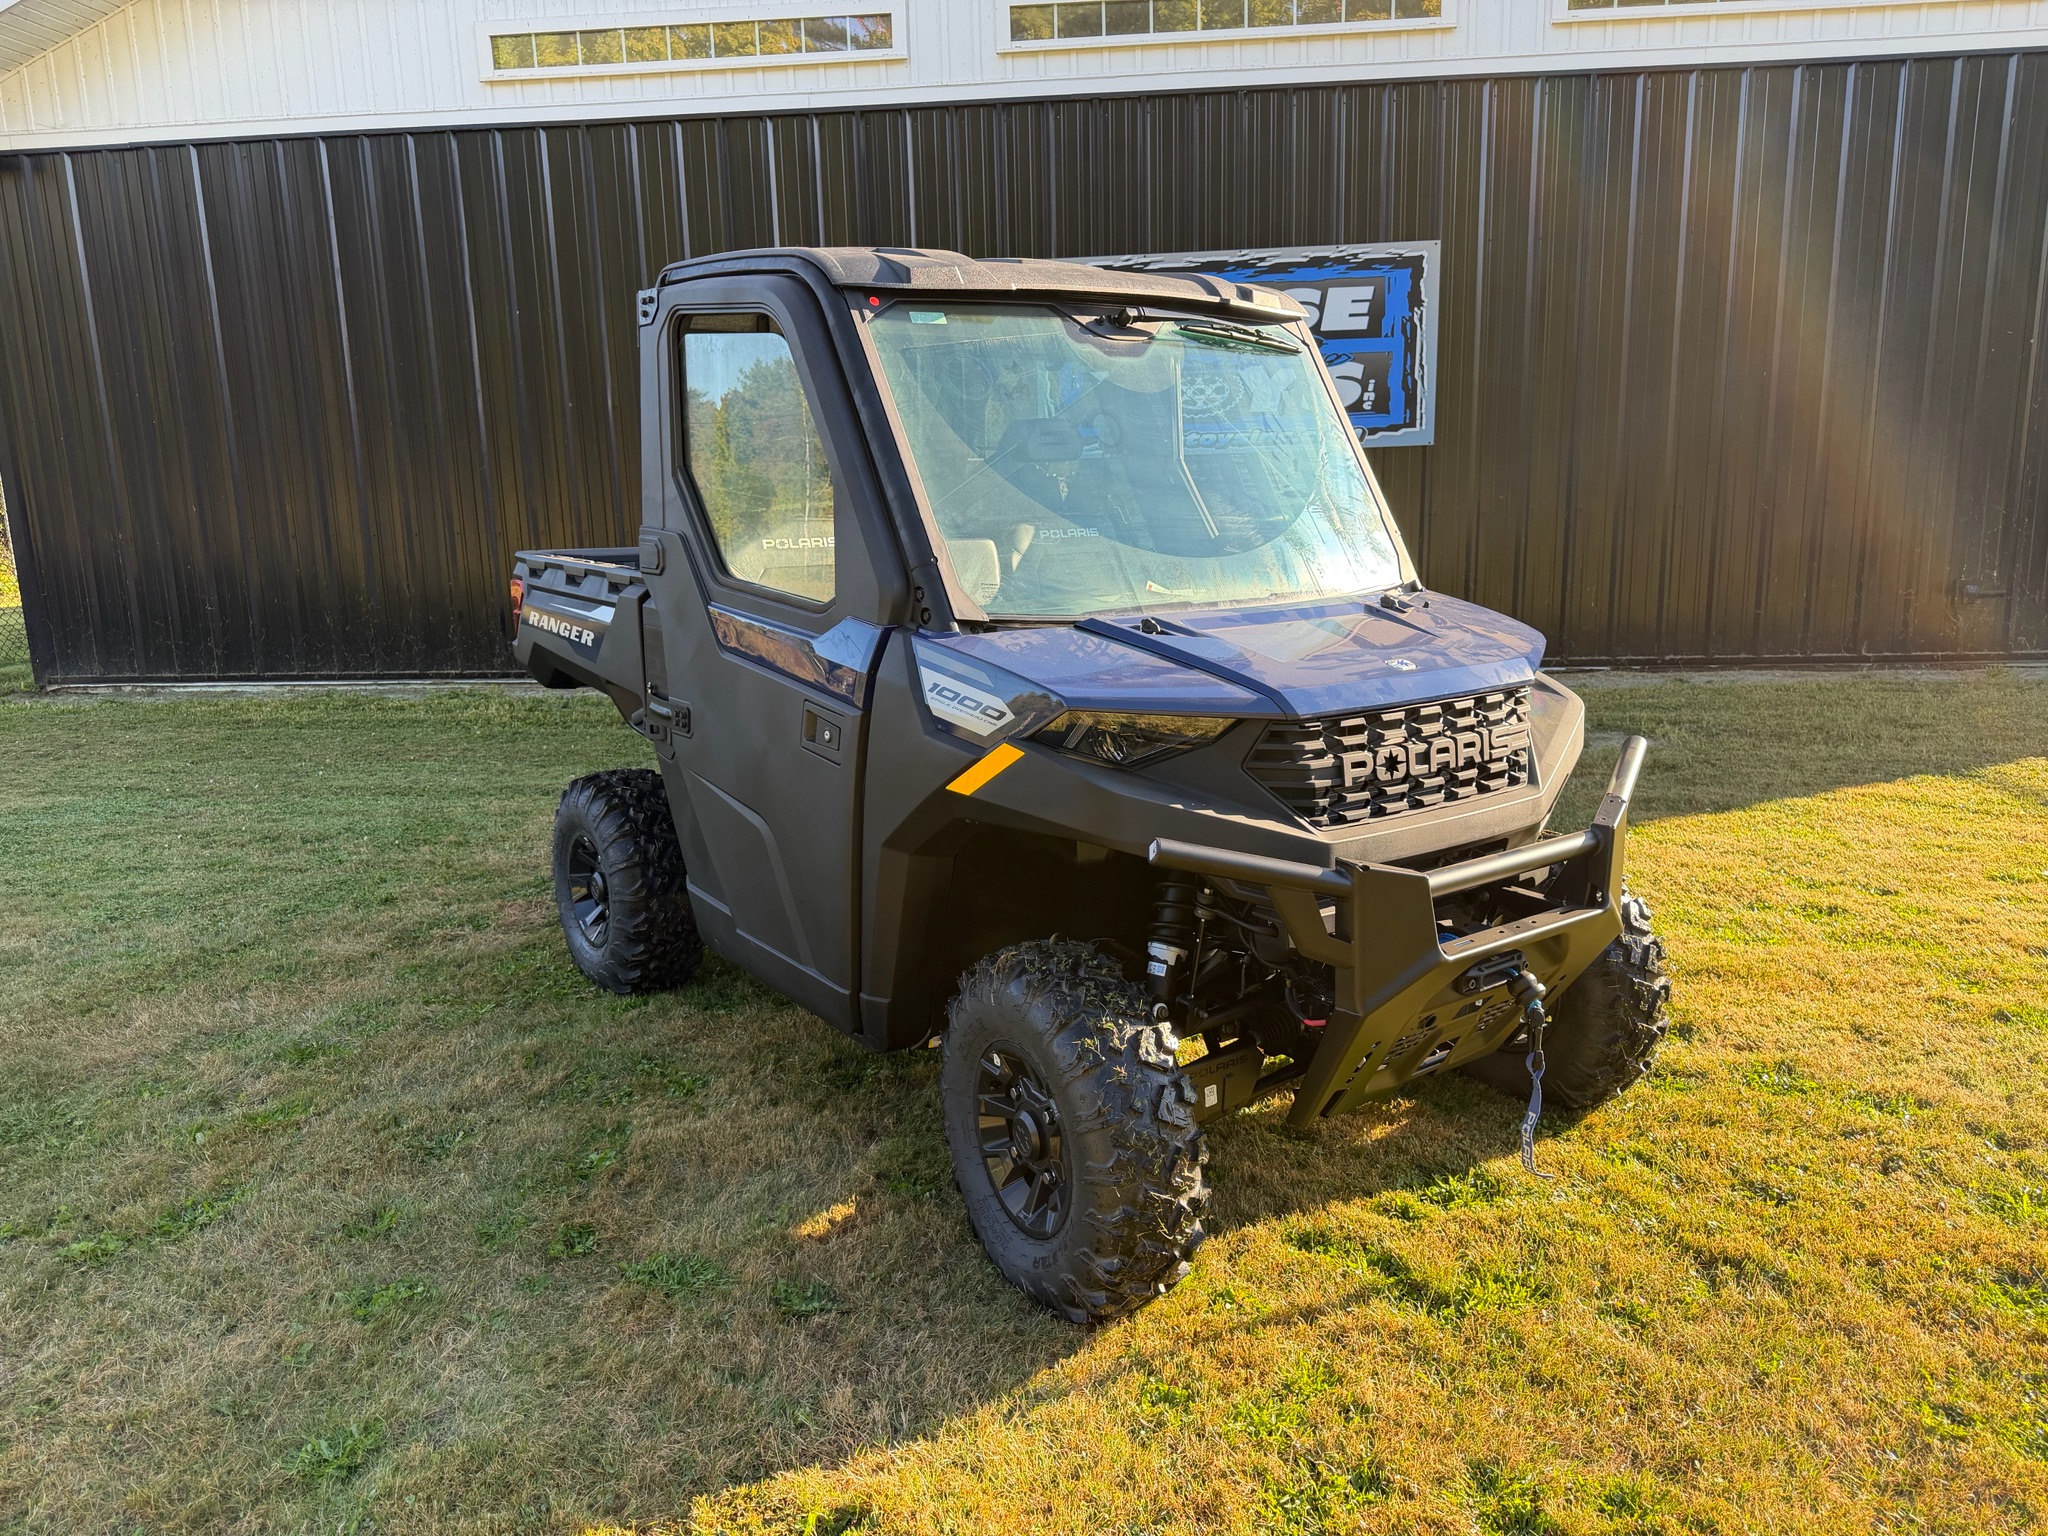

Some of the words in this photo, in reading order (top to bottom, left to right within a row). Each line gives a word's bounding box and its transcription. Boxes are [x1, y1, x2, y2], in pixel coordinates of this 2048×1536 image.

[1362, 379, 1376, 410] inc
[762, 536, 835, 550] POLARIS
[1039, 527, 1099, 539] POLARIS
[528, 610, 595, 647] RANGER
[927, 682, 1007, 721] 1000
[1337, 728, 1513, 787] POLARIS
